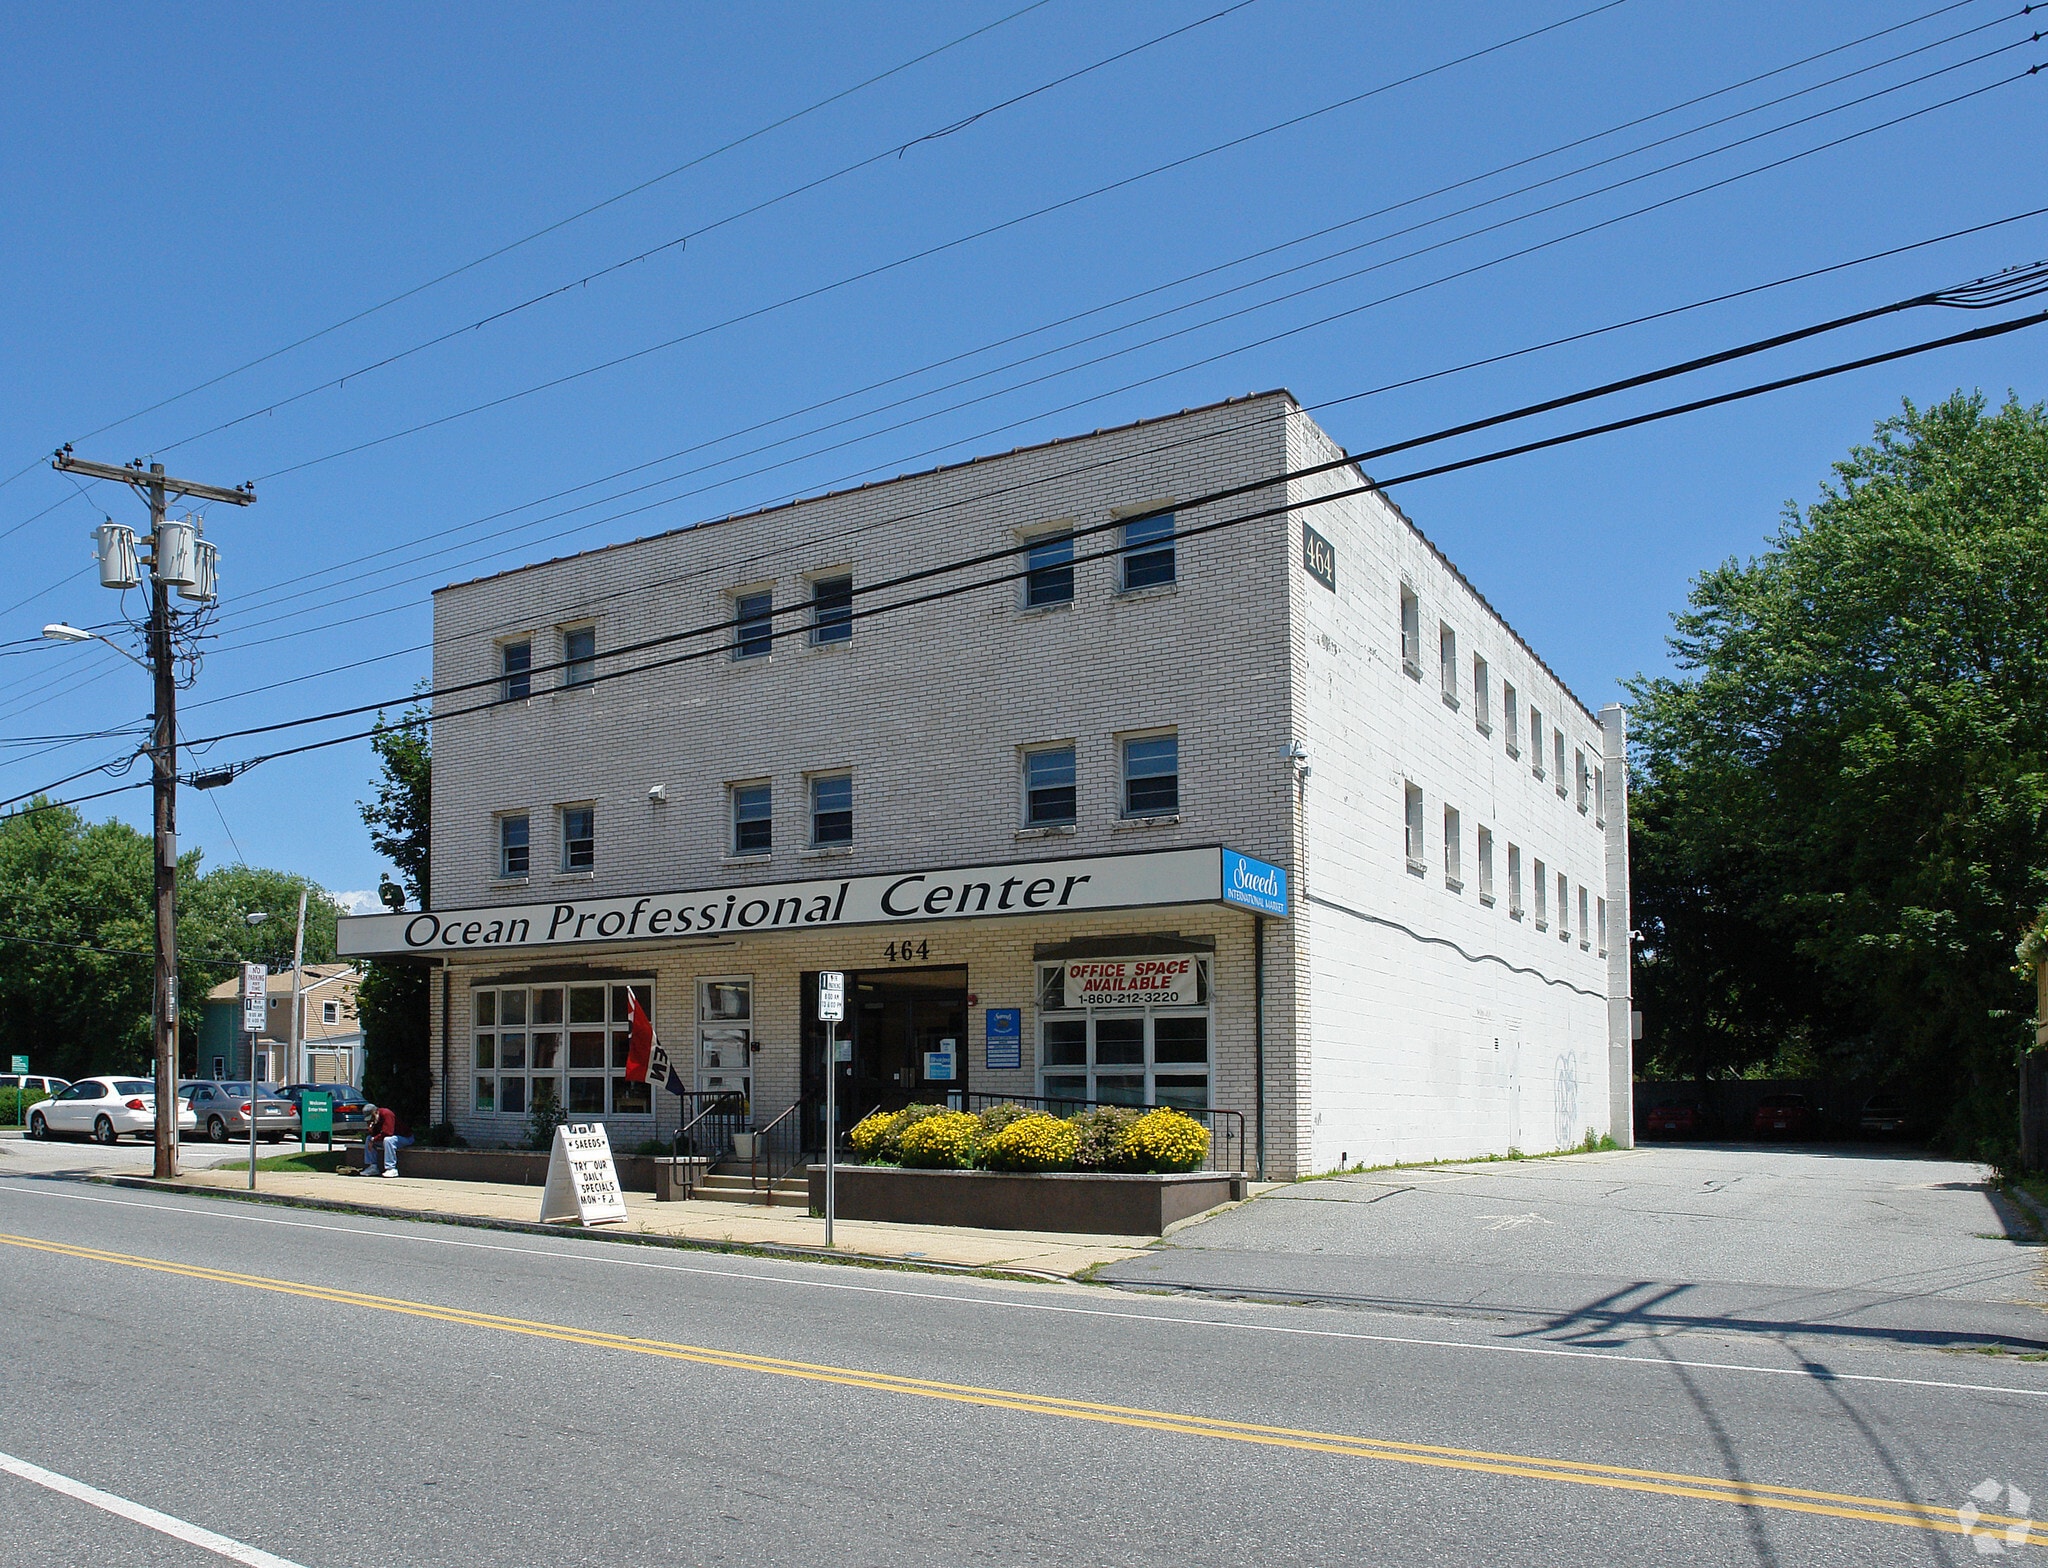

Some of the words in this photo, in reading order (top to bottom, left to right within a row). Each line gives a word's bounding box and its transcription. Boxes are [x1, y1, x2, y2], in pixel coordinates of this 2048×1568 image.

[1306, 534, 1333, 583] 464
[1233, 857, 1278, 898] Saeed's
[1227, 887, 1265, 908] INTERNATIONAL
[1265, 898, 1284, 913] MARKET
[404, 913, 531, 948] Ocean
[546, 881, 851, 941] Professional
[880, 874, 1092, 917] Center
[883, 939, 930, 962] 464
[1069, 963, 1126, 979] OFFICE
[1134, 959, 1190, 976] SPACE
[1083, 975, 1172, 992] AVAILABLE
[1078, 991, 1179, 1005] 1-860-212-3220
[574, 1138, 602, 1149] SAEEDS
[573, 1161, 588, 1172] TRY
[593, 1160, 608, 1171] OUR
[583, 1171, 604, 1182] DAILY
[581, 1181, 615, 1194] SPECIALS
